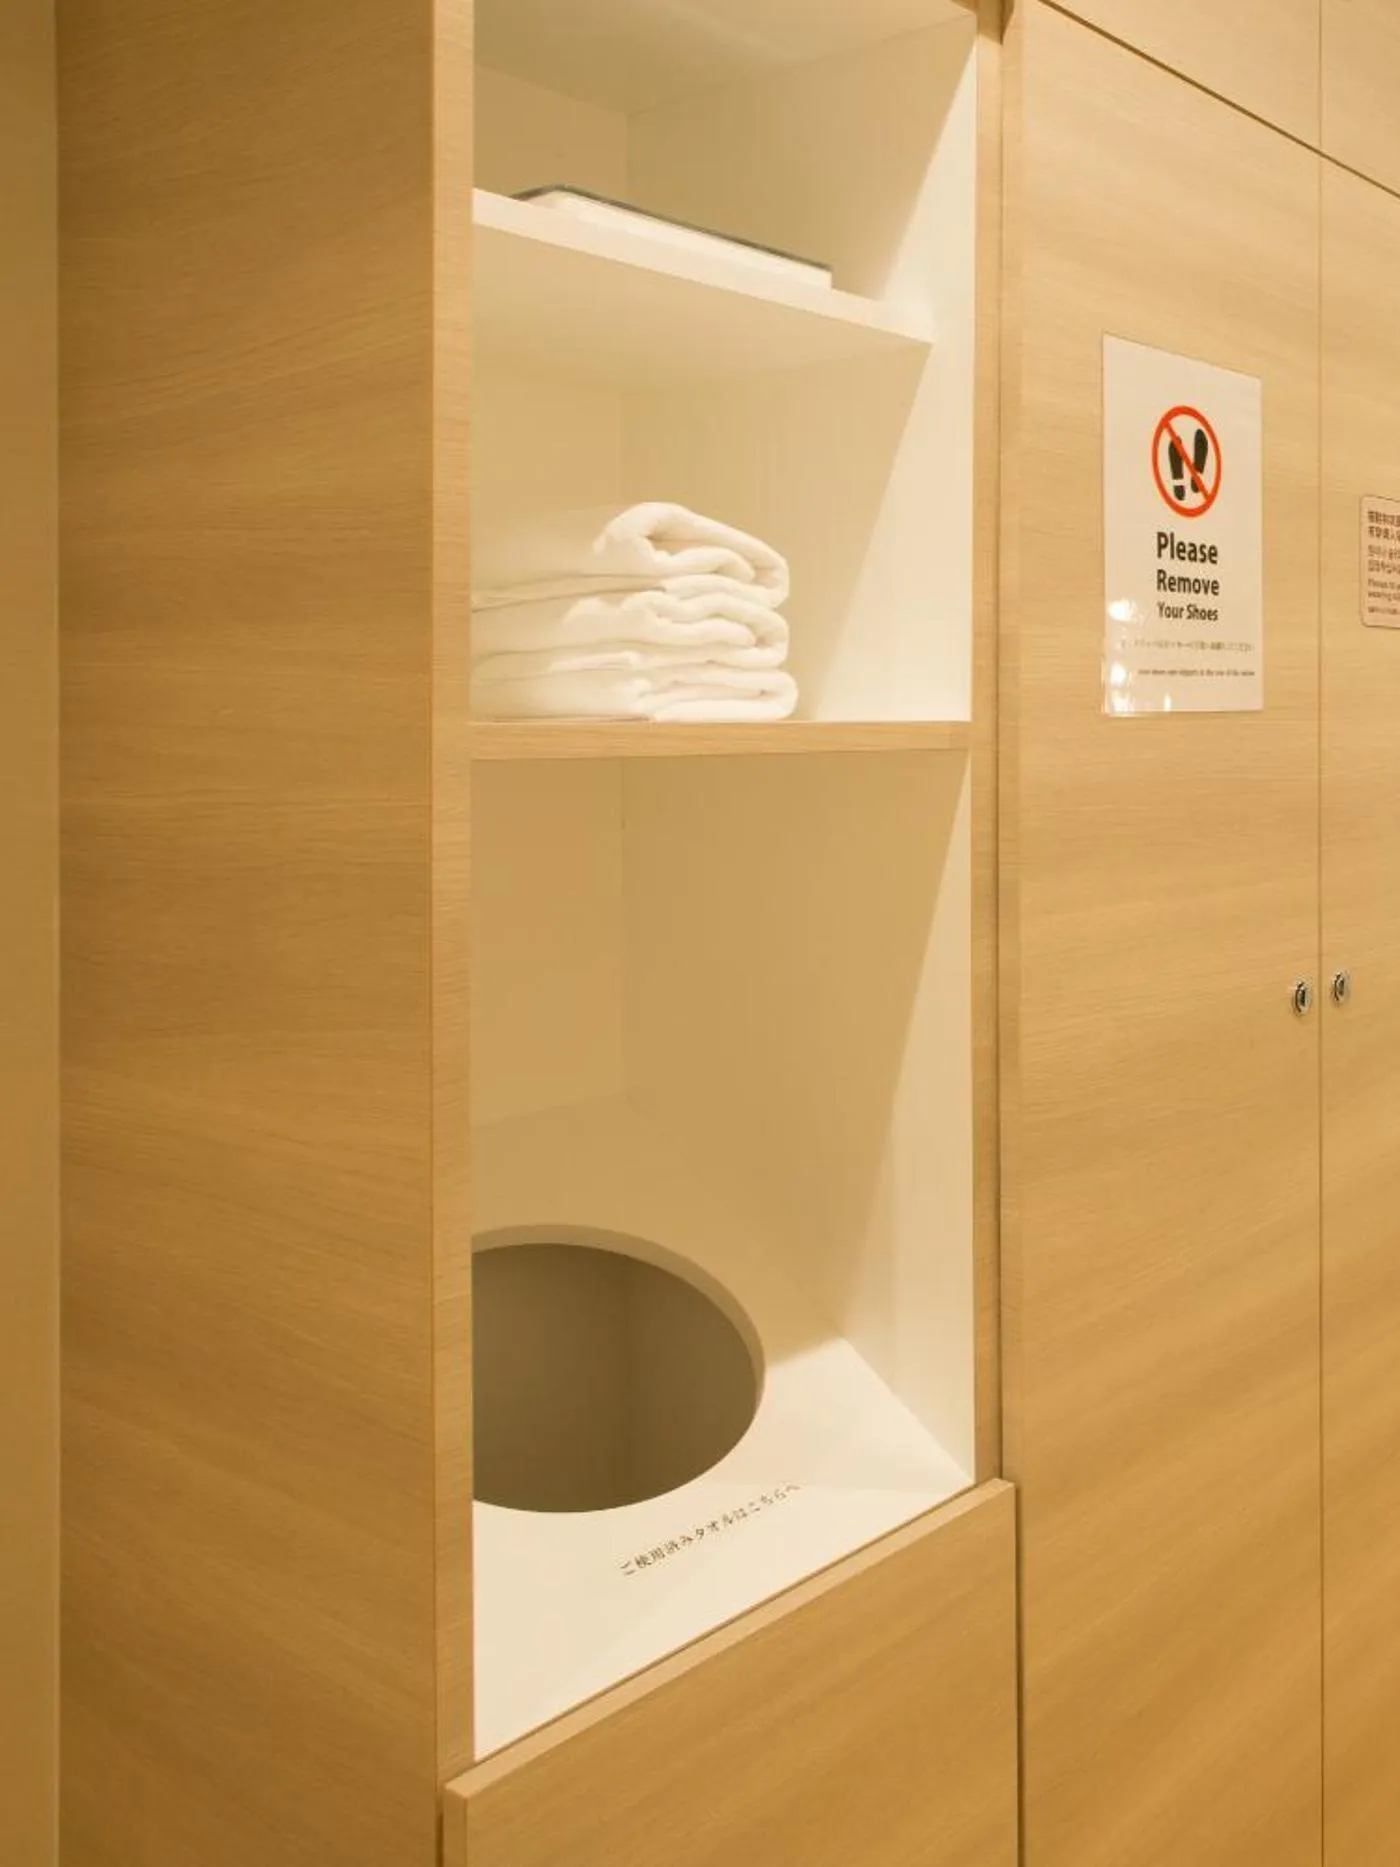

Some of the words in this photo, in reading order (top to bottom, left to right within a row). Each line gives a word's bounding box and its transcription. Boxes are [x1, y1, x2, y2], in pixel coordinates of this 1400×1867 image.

[1157, 531, 1218, 565] Please
[1156, 568, 1220, 596] Remove
[1157, 602, 1184, 618] Your
[1186, 603, 1218, 621] Shoes
